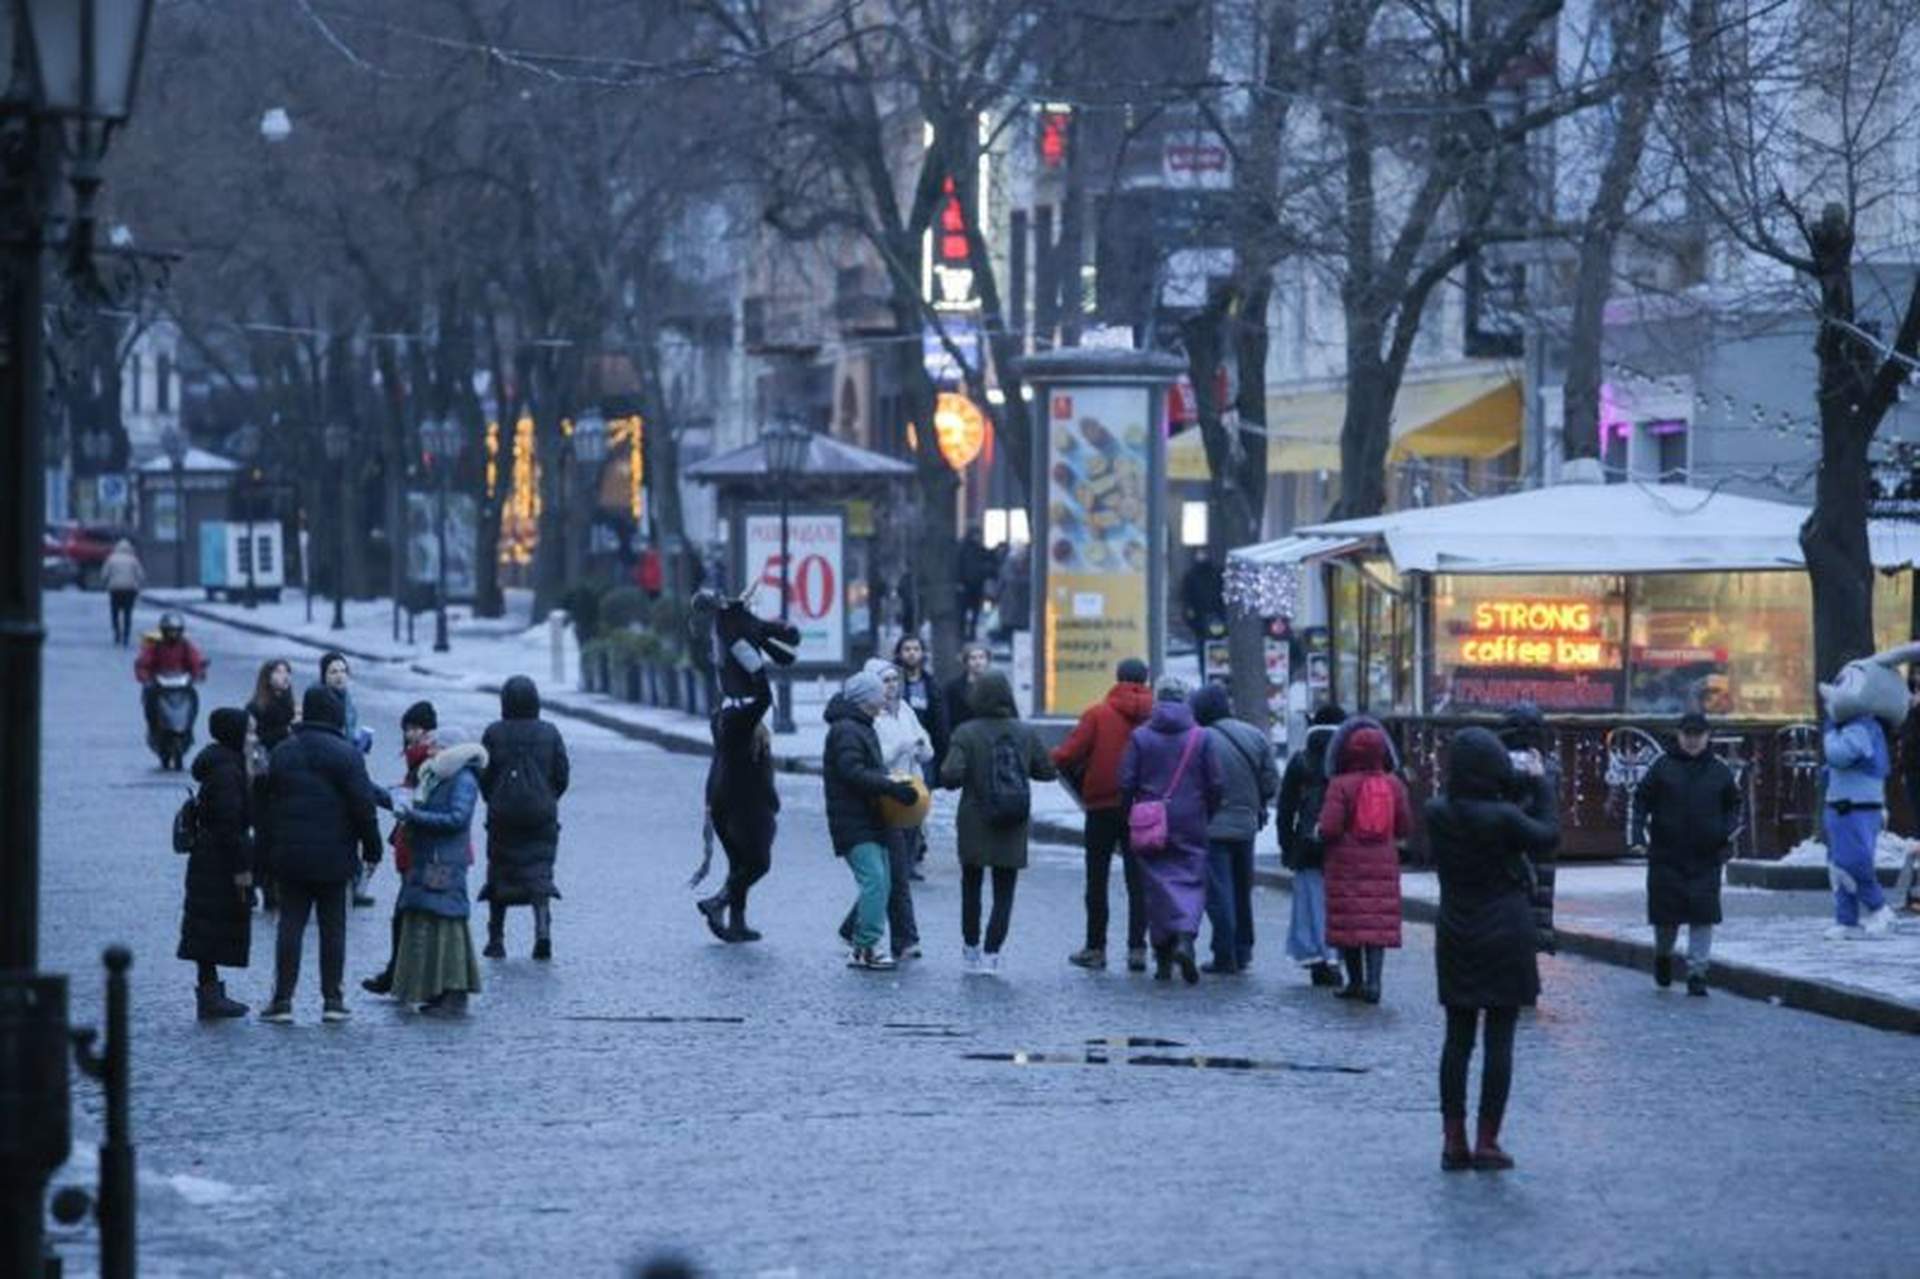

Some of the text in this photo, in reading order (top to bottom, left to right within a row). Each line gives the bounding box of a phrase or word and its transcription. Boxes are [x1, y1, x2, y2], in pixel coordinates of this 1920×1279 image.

[762, 554, 835, 620] 50
[1476, 602, 1590, 632] STRONG
[1462, 635, 1600, 664] coffee bar
